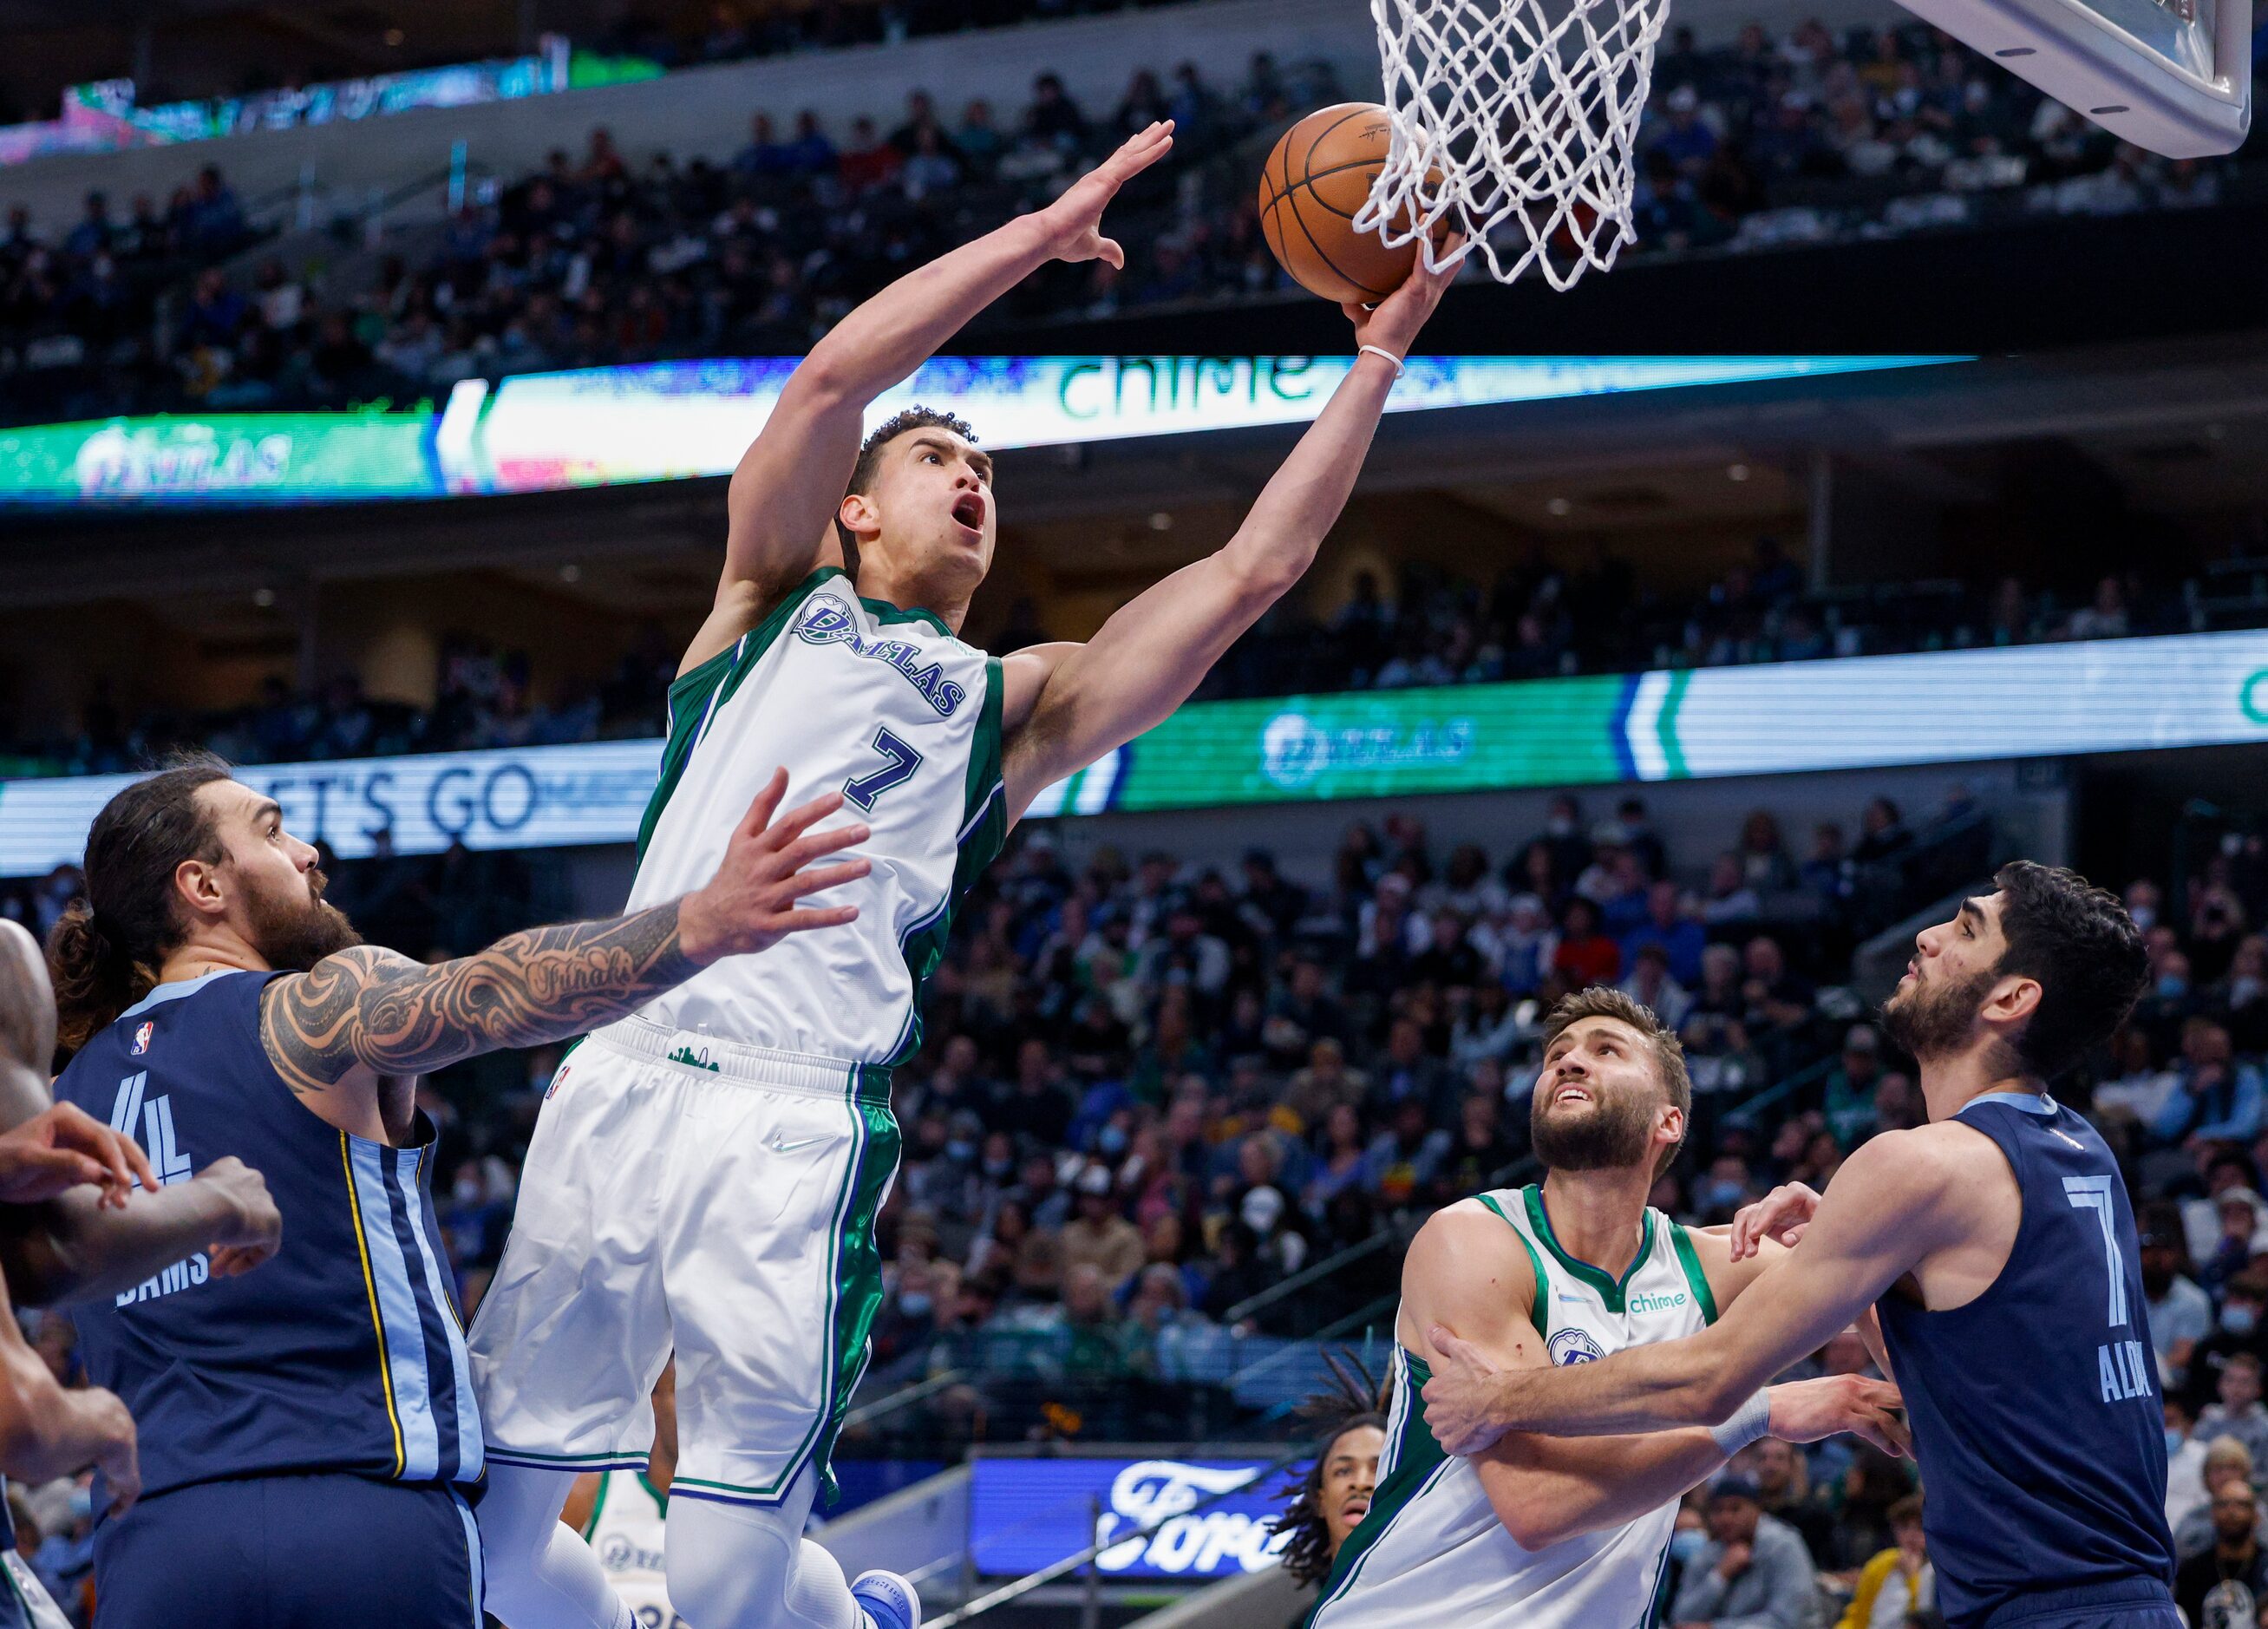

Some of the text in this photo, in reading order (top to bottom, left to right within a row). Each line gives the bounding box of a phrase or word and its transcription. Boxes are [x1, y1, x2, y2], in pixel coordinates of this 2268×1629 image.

[792, 599, 966, 716] DALLAS
[430, 765, 538, 833] GO
[842, 727, 924, 814] 7
[110, 1070, 193, 1188] 4
[2062, 1174, 2127, 1327] 7
[1630, 1292, 1686, 1314] chime
